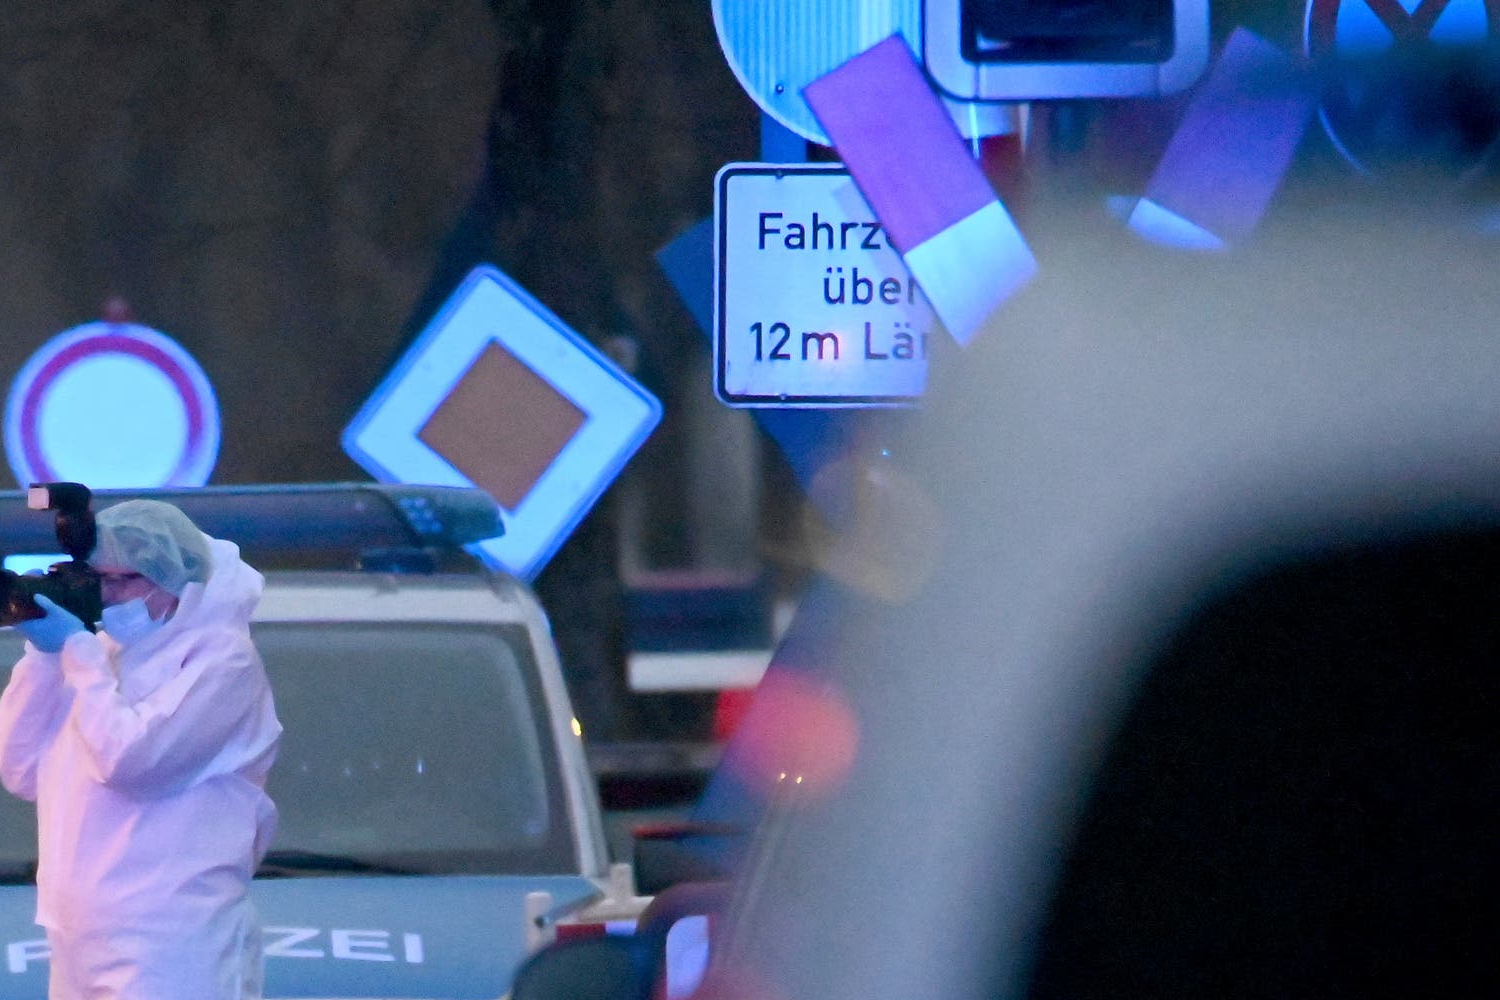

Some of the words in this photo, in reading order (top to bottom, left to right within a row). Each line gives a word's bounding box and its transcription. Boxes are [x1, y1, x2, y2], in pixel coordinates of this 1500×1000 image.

[758, 211, 897, 251] Fahrz
[864, 321, 928, 361] Lä
[7, 926, 424, 974] PZEI
